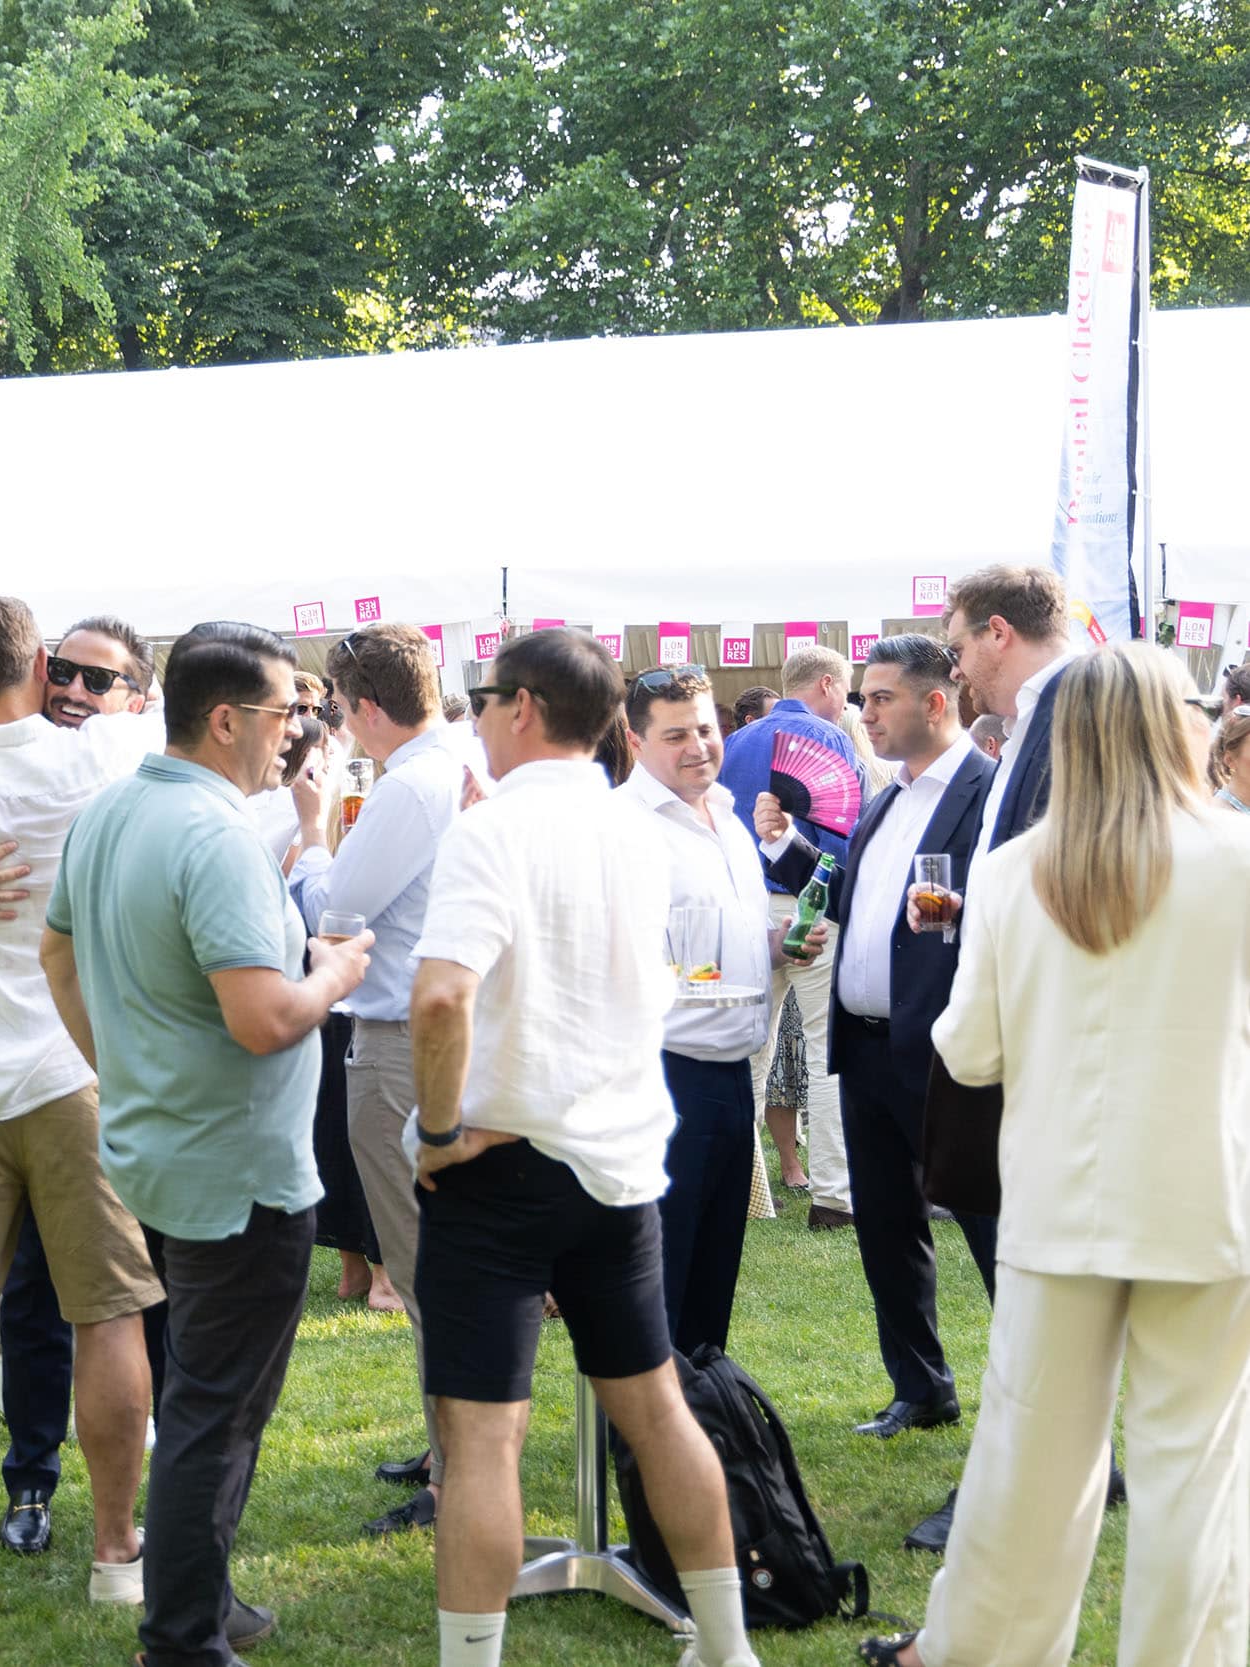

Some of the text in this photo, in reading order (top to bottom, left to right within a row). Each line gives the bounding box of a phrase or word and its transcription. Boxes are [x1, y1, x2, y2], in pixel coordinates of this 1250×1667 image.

[358, 600, 377, 612] RES
[359, 609, 378, 620] LON
[1185, 622, 1206, 632] LON
[1184, 631, 1205, 642] RES
[479, 637, 497, 647] LON
[664, 640, 684, 650] LON
[727, 641, 747, 651] LON
[664, 650, 684, 660] RES
[726, 651, 747, 661] RES
